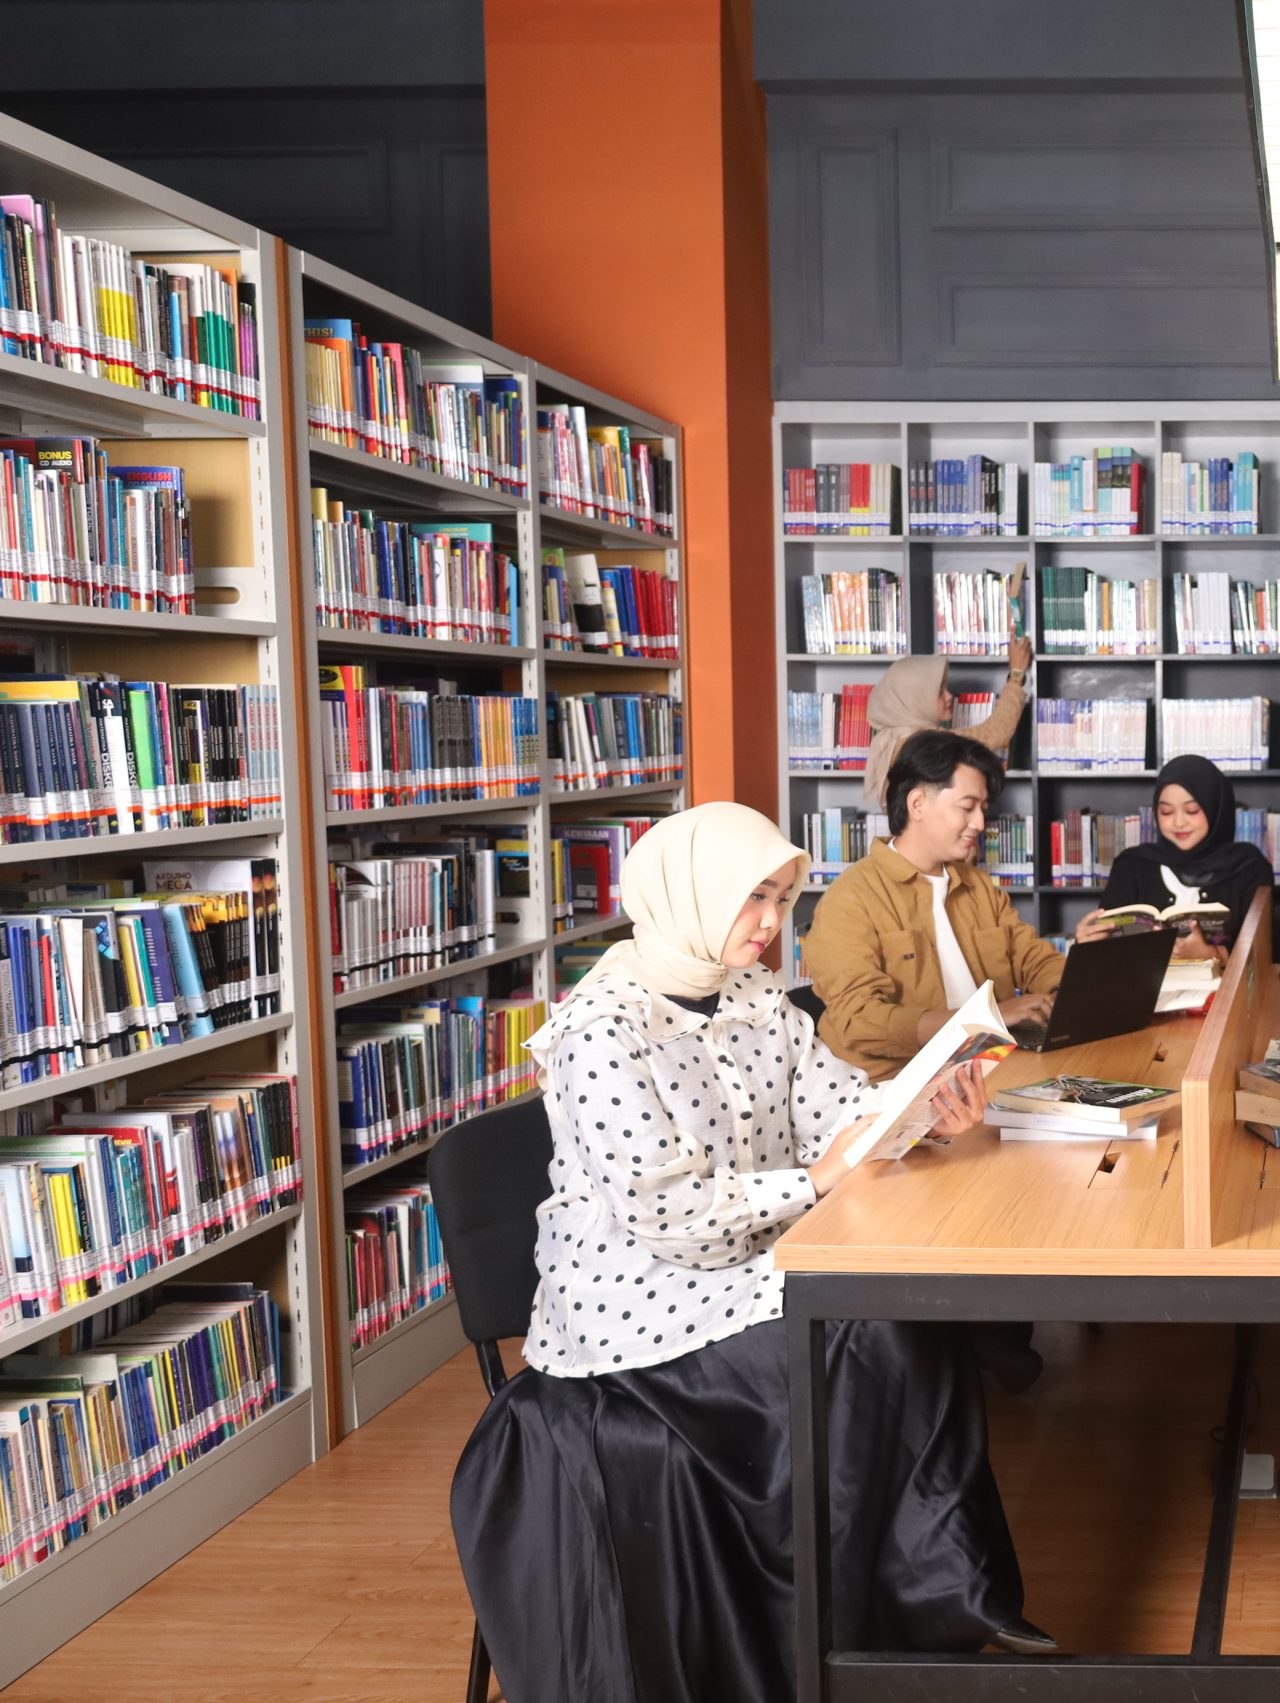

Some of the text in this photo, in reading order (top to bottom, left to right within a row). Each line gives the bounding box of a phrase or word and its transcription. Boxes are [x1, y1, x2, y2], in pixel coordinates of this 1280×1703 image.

[38, 451, 72, 460] BONUS
[127, 472, 172, 481] ENGLISH
[156, 872, 192, 880] ARDUINO
[156, 880, 193, 890] MEGA
